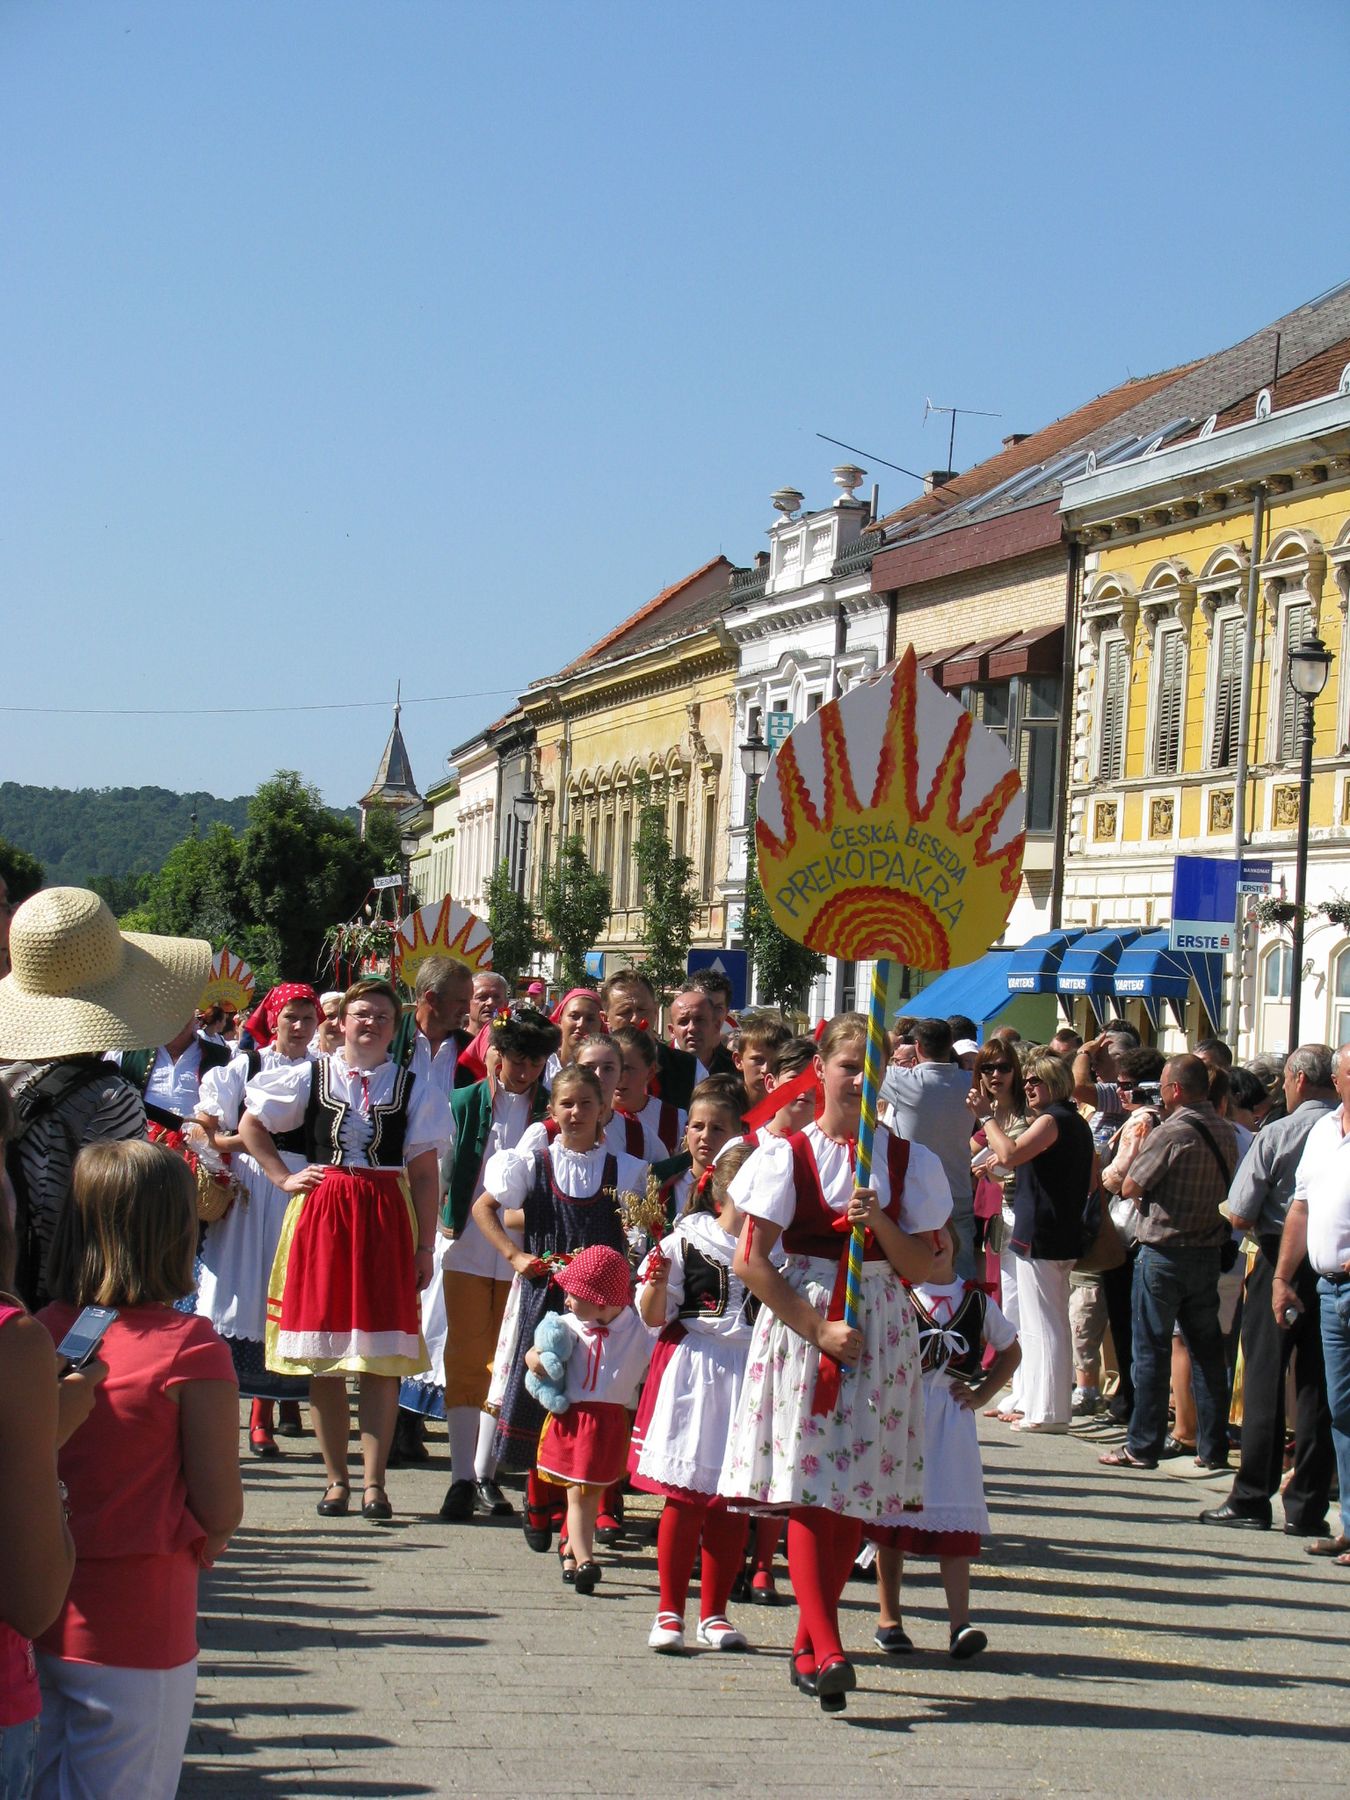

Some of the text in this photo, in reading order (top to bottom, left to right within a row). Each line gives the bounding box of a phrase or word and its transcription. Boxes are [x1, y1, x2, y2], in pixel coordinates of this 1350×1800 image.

[830, 820, 968, 887] ČESKÁ BESEDA
[775, 850, 966, 929] PREKOPAKRA
[1242, 884, 1263, 893] ERSTE
[1176, 935, 1219, 949] ERSTE
